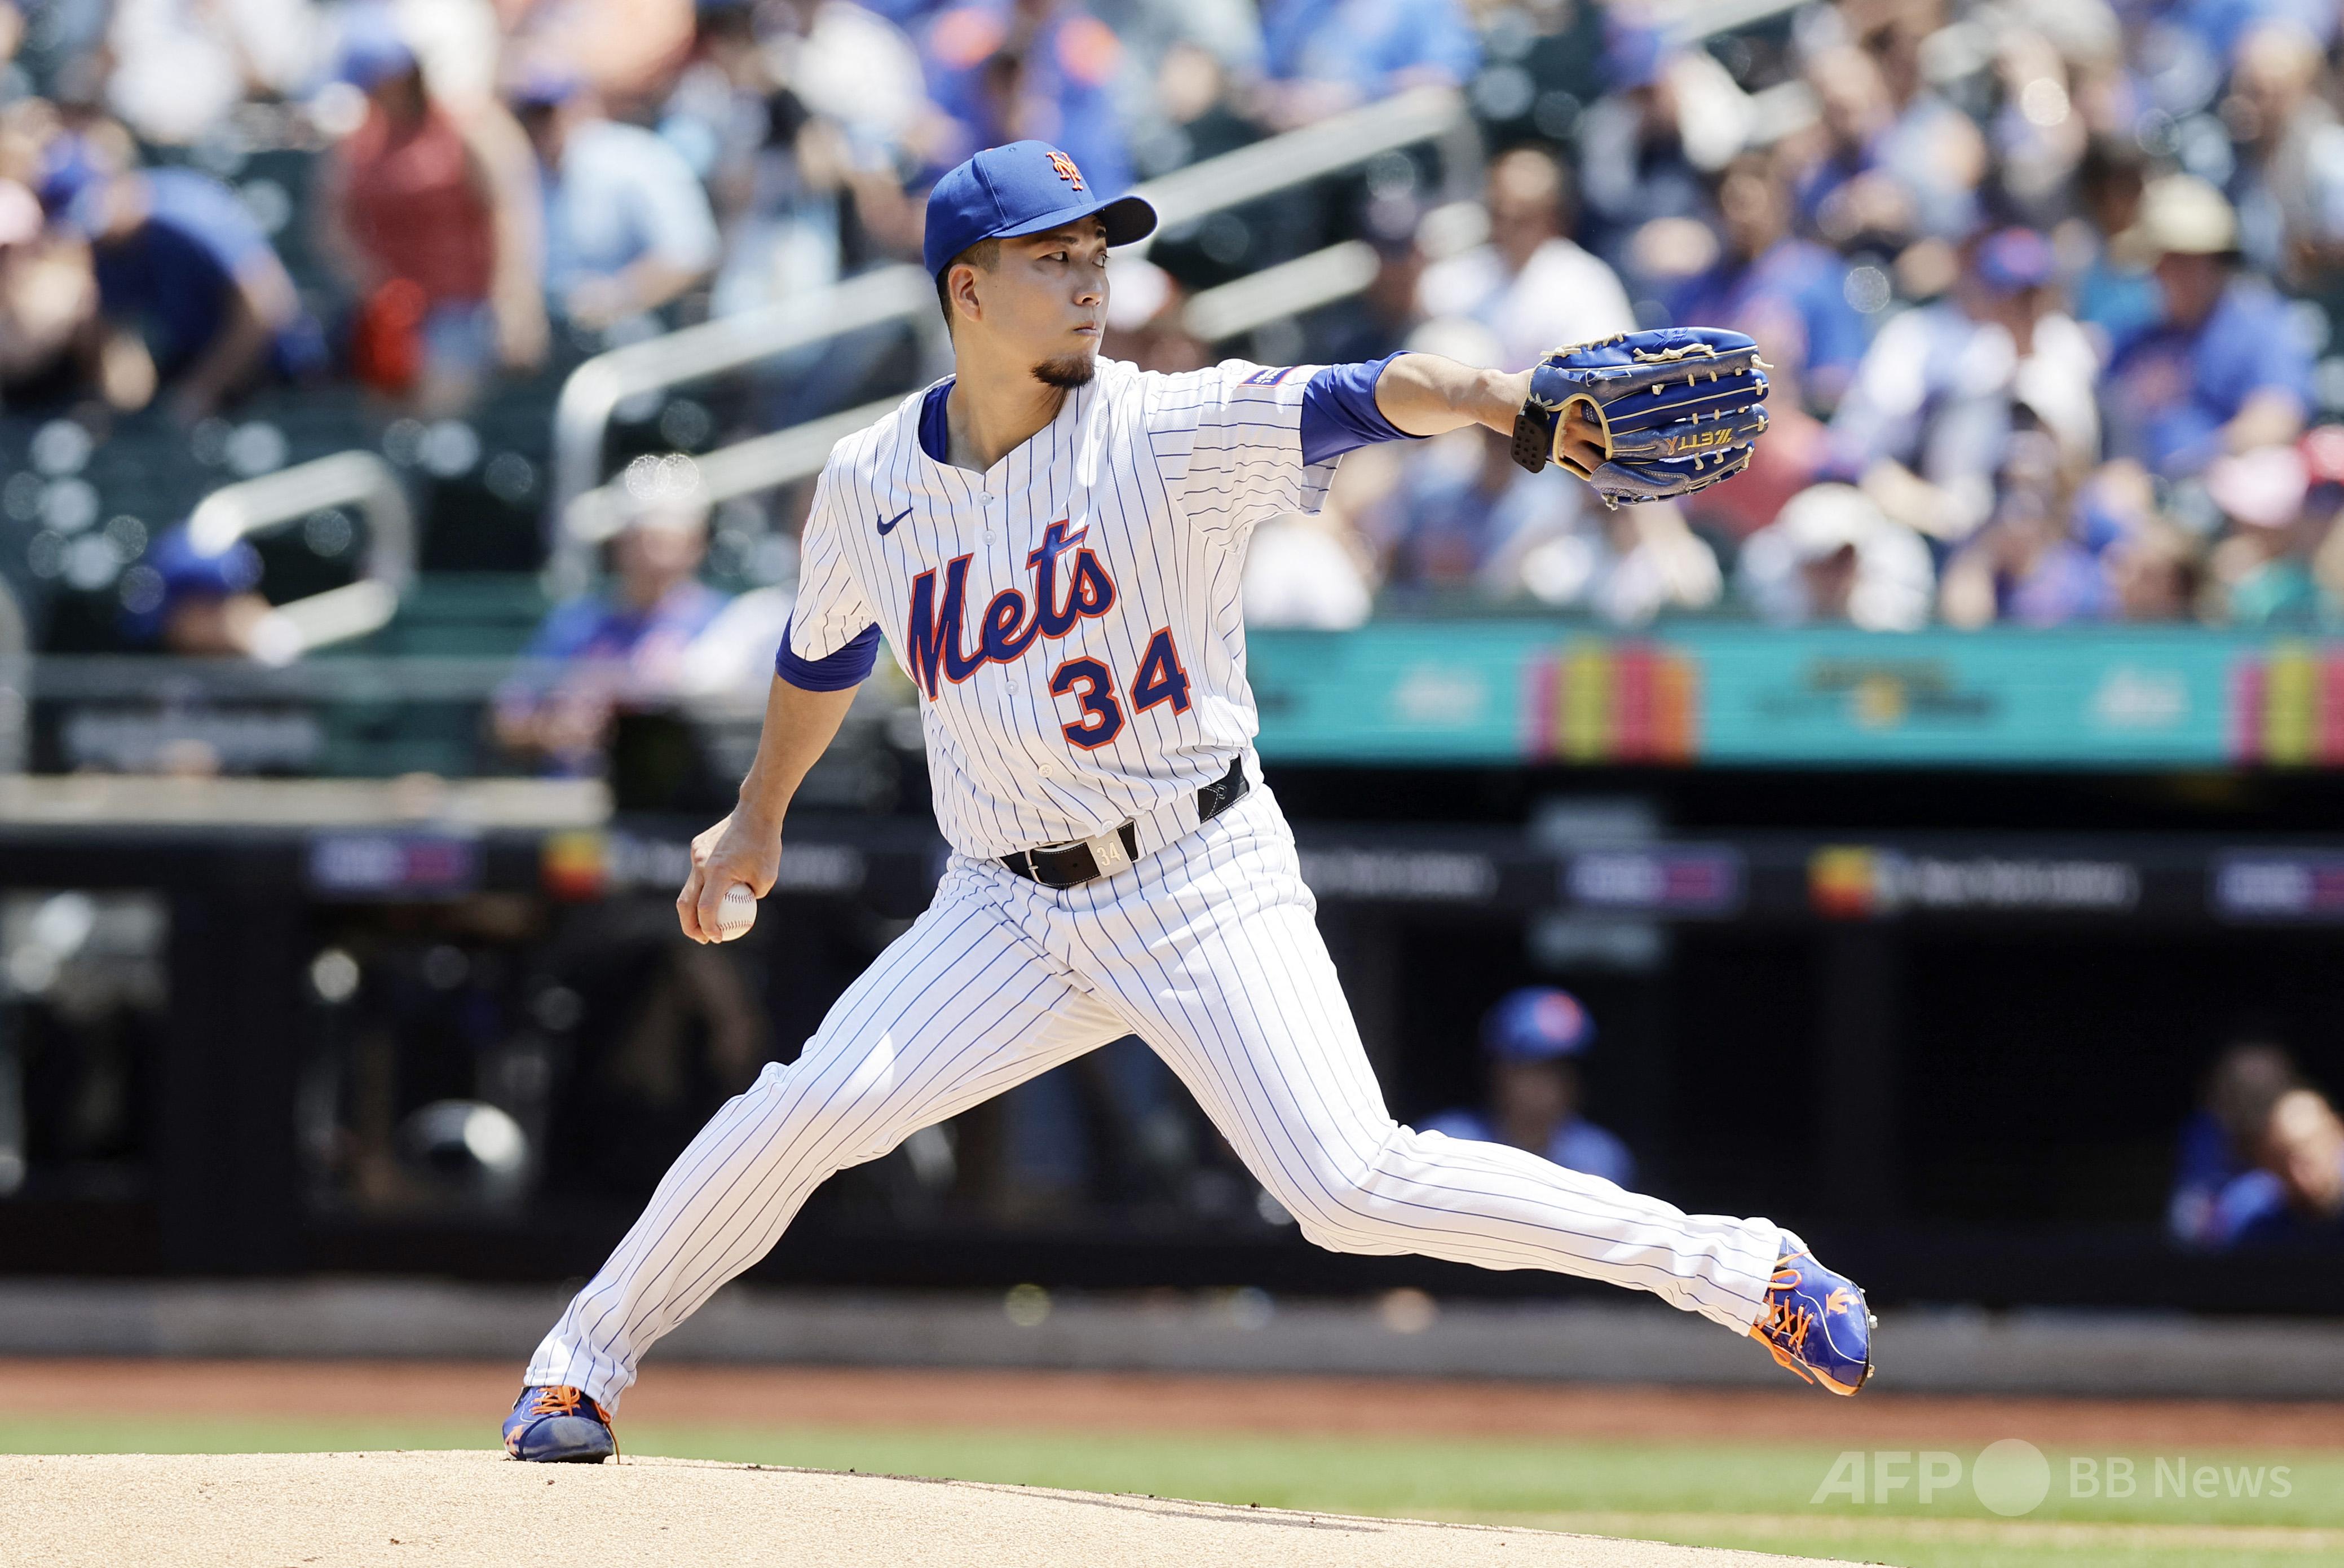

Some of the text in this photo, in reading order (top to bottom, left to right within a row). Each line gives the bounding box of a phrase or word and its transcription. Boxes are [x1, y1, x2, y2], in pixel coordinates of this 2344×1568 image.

[1046, 151, 1083, 191] NY
[1678, 427, 1733, 451] ZETT
[906, 519, 1117, 703] Mets
[1049, 626, 1191, 751] 34
[1096, 841, 1121, 866] 34
